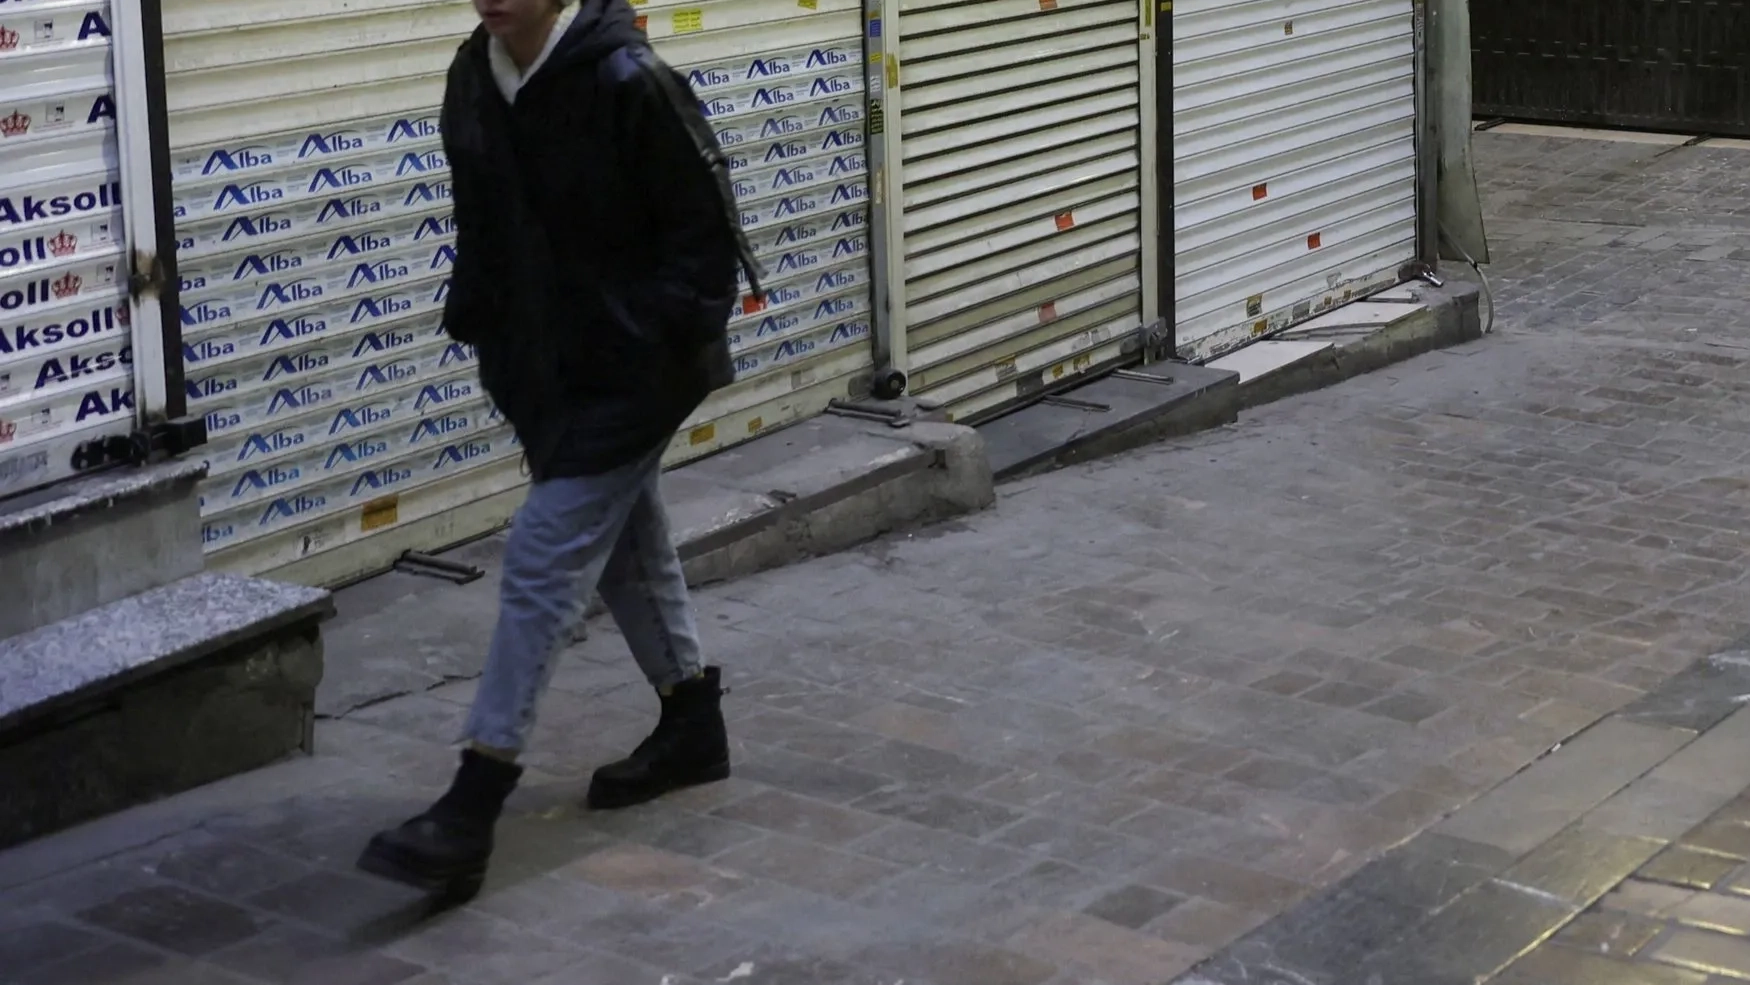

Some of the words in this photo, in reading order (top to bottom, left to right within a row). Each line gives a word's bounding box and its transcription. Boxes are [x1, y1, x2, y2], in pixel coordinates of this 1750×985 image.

[198, 146, 272, 176] Alba
[294, 130, 363, 158] Alba
[212, 180, 283, 210] Alba
[304, 164, 372, 192] Alba
[220, 211, 292, 242] Alba
[315, 195, 382, 223] Alba
[233, 250, 302, 282] Alba
[327, 230, 390, 262] Alba
[254, 278, 323, 309] Alba
[344, 259, 408, 288] Alba
[258, 314, 326, 346] Alba
[350, 293, 411, 323] Alba
[262, 350, 328, 381] Alba
[352, 328, 413, 358] Alba
[263, 380, 332, 415] Alba
[355, 360, 416, 390] Alba
[237, 429, 304, 460] Alba
[328, 404, 390, 435] Alba
[231, 464, 299, 498] Alba
[324, 438, 386, 469] Alba
[259, 493, 326, 524] Alba
[348, 465, 411, 496] Alba
